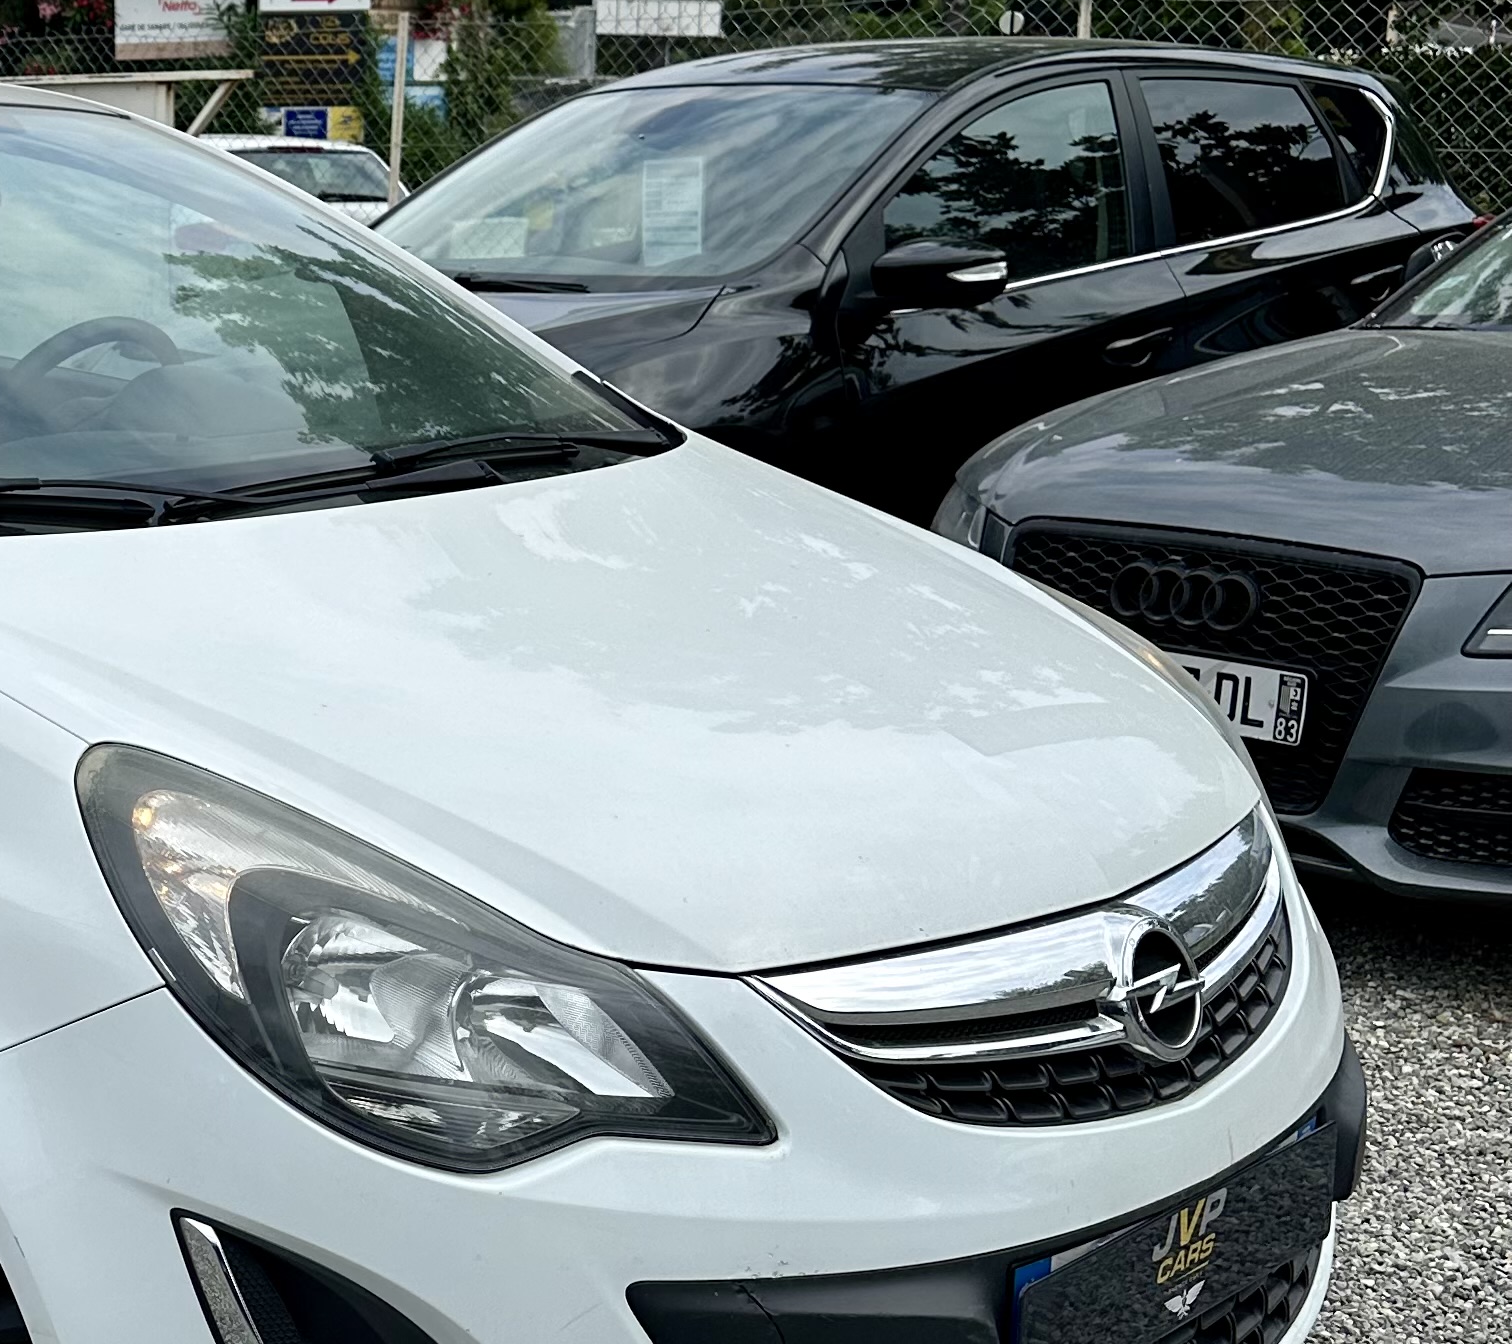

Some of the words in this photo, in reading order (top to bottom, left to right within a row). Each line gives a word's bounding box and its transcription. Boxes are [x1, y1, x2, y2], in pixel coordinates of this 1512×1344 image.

[162, 0, 197, 12] Netto
[1275, 717, 1298, 743] 83
[1152, 1187, 1227, 1261] JVP
[1156, 1233, 1216, 1284] CARS
